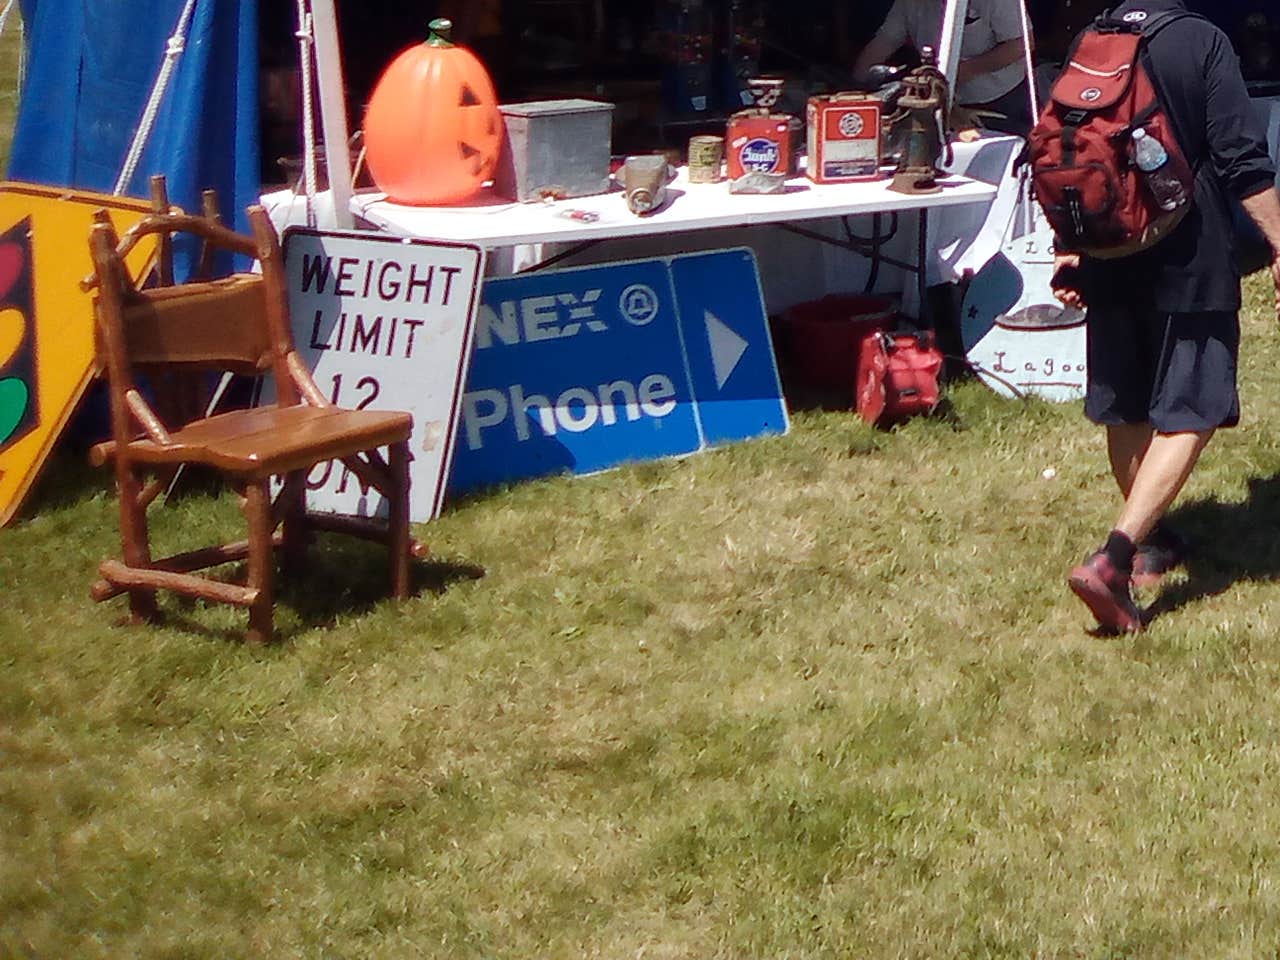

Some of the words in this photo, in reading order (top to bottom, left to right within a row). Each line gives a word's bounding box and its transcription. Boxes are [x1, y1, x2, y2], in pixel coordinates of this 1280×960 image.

[301, 253, 461, 306] WEIGHT
[309, 310, 424, 358] LIMIT
[476, 289, 609, 349] NEX
[330, 374, 380, 411] 12
[464, 374, 676, 451] Phone
